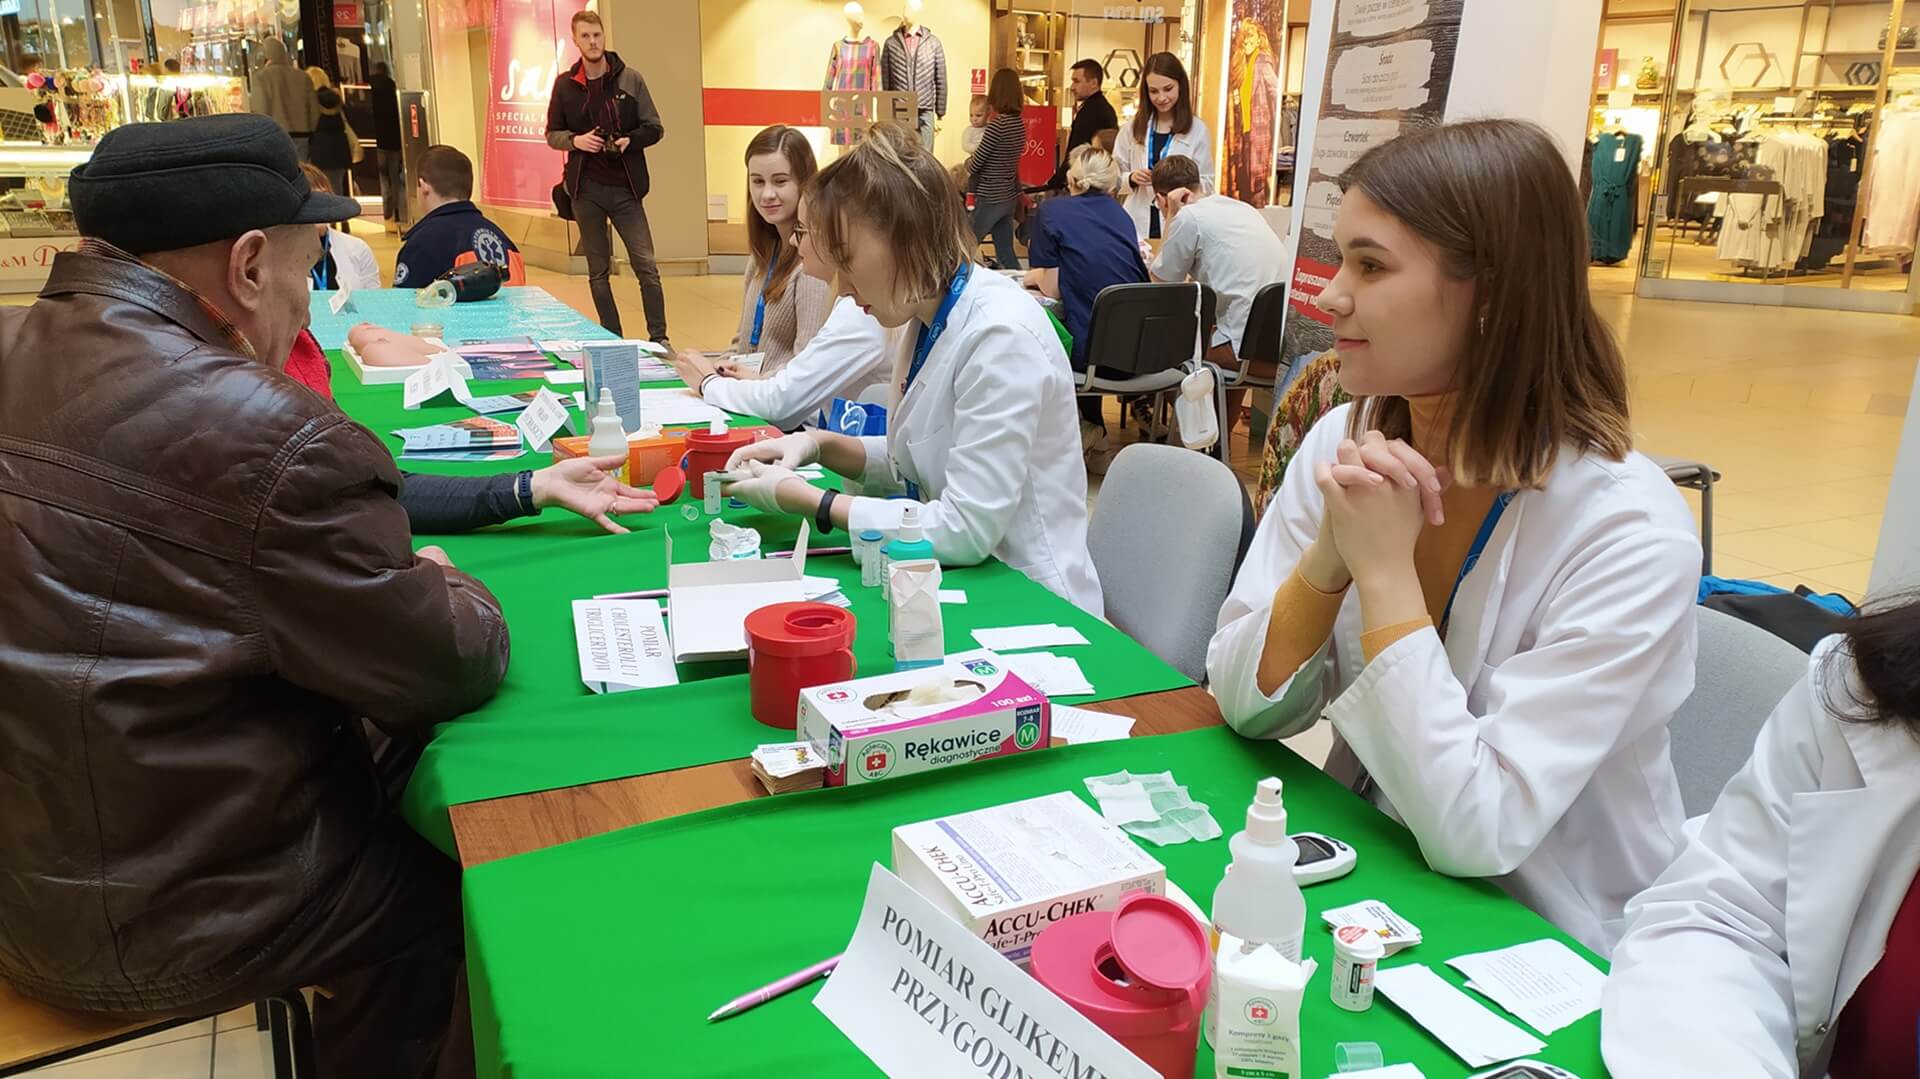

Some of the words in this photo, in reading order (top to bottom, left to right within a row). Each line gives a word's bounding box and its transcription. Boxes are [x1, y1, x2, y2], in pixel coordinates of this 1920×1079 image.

[496, 111, 536, 122] SPECIAL
[828, 94, 910, 123] SALE
[495, 125, 536, 136] SPECIAL
[610, 607, 639, 671] CHOLESTEROLU
[639, 625, 663, 659] POMIAR
[990, 697, 1015, 708] 100
[904, 728, 1001, 761] Rękawice
[1020, 726, 1036, 744] M
[930, 743, 1001, 767] diagnostyczne
[923, 845, 995, 907] ACCU-CHEK
[983, 895, 1098, 939] ACCU-CHEK
[986, 930, 1044, 950] afe-T-Pr
[881, 905, 976, 1001] POMIAR
[979, 986, 1108, 1079] GLIKEM
